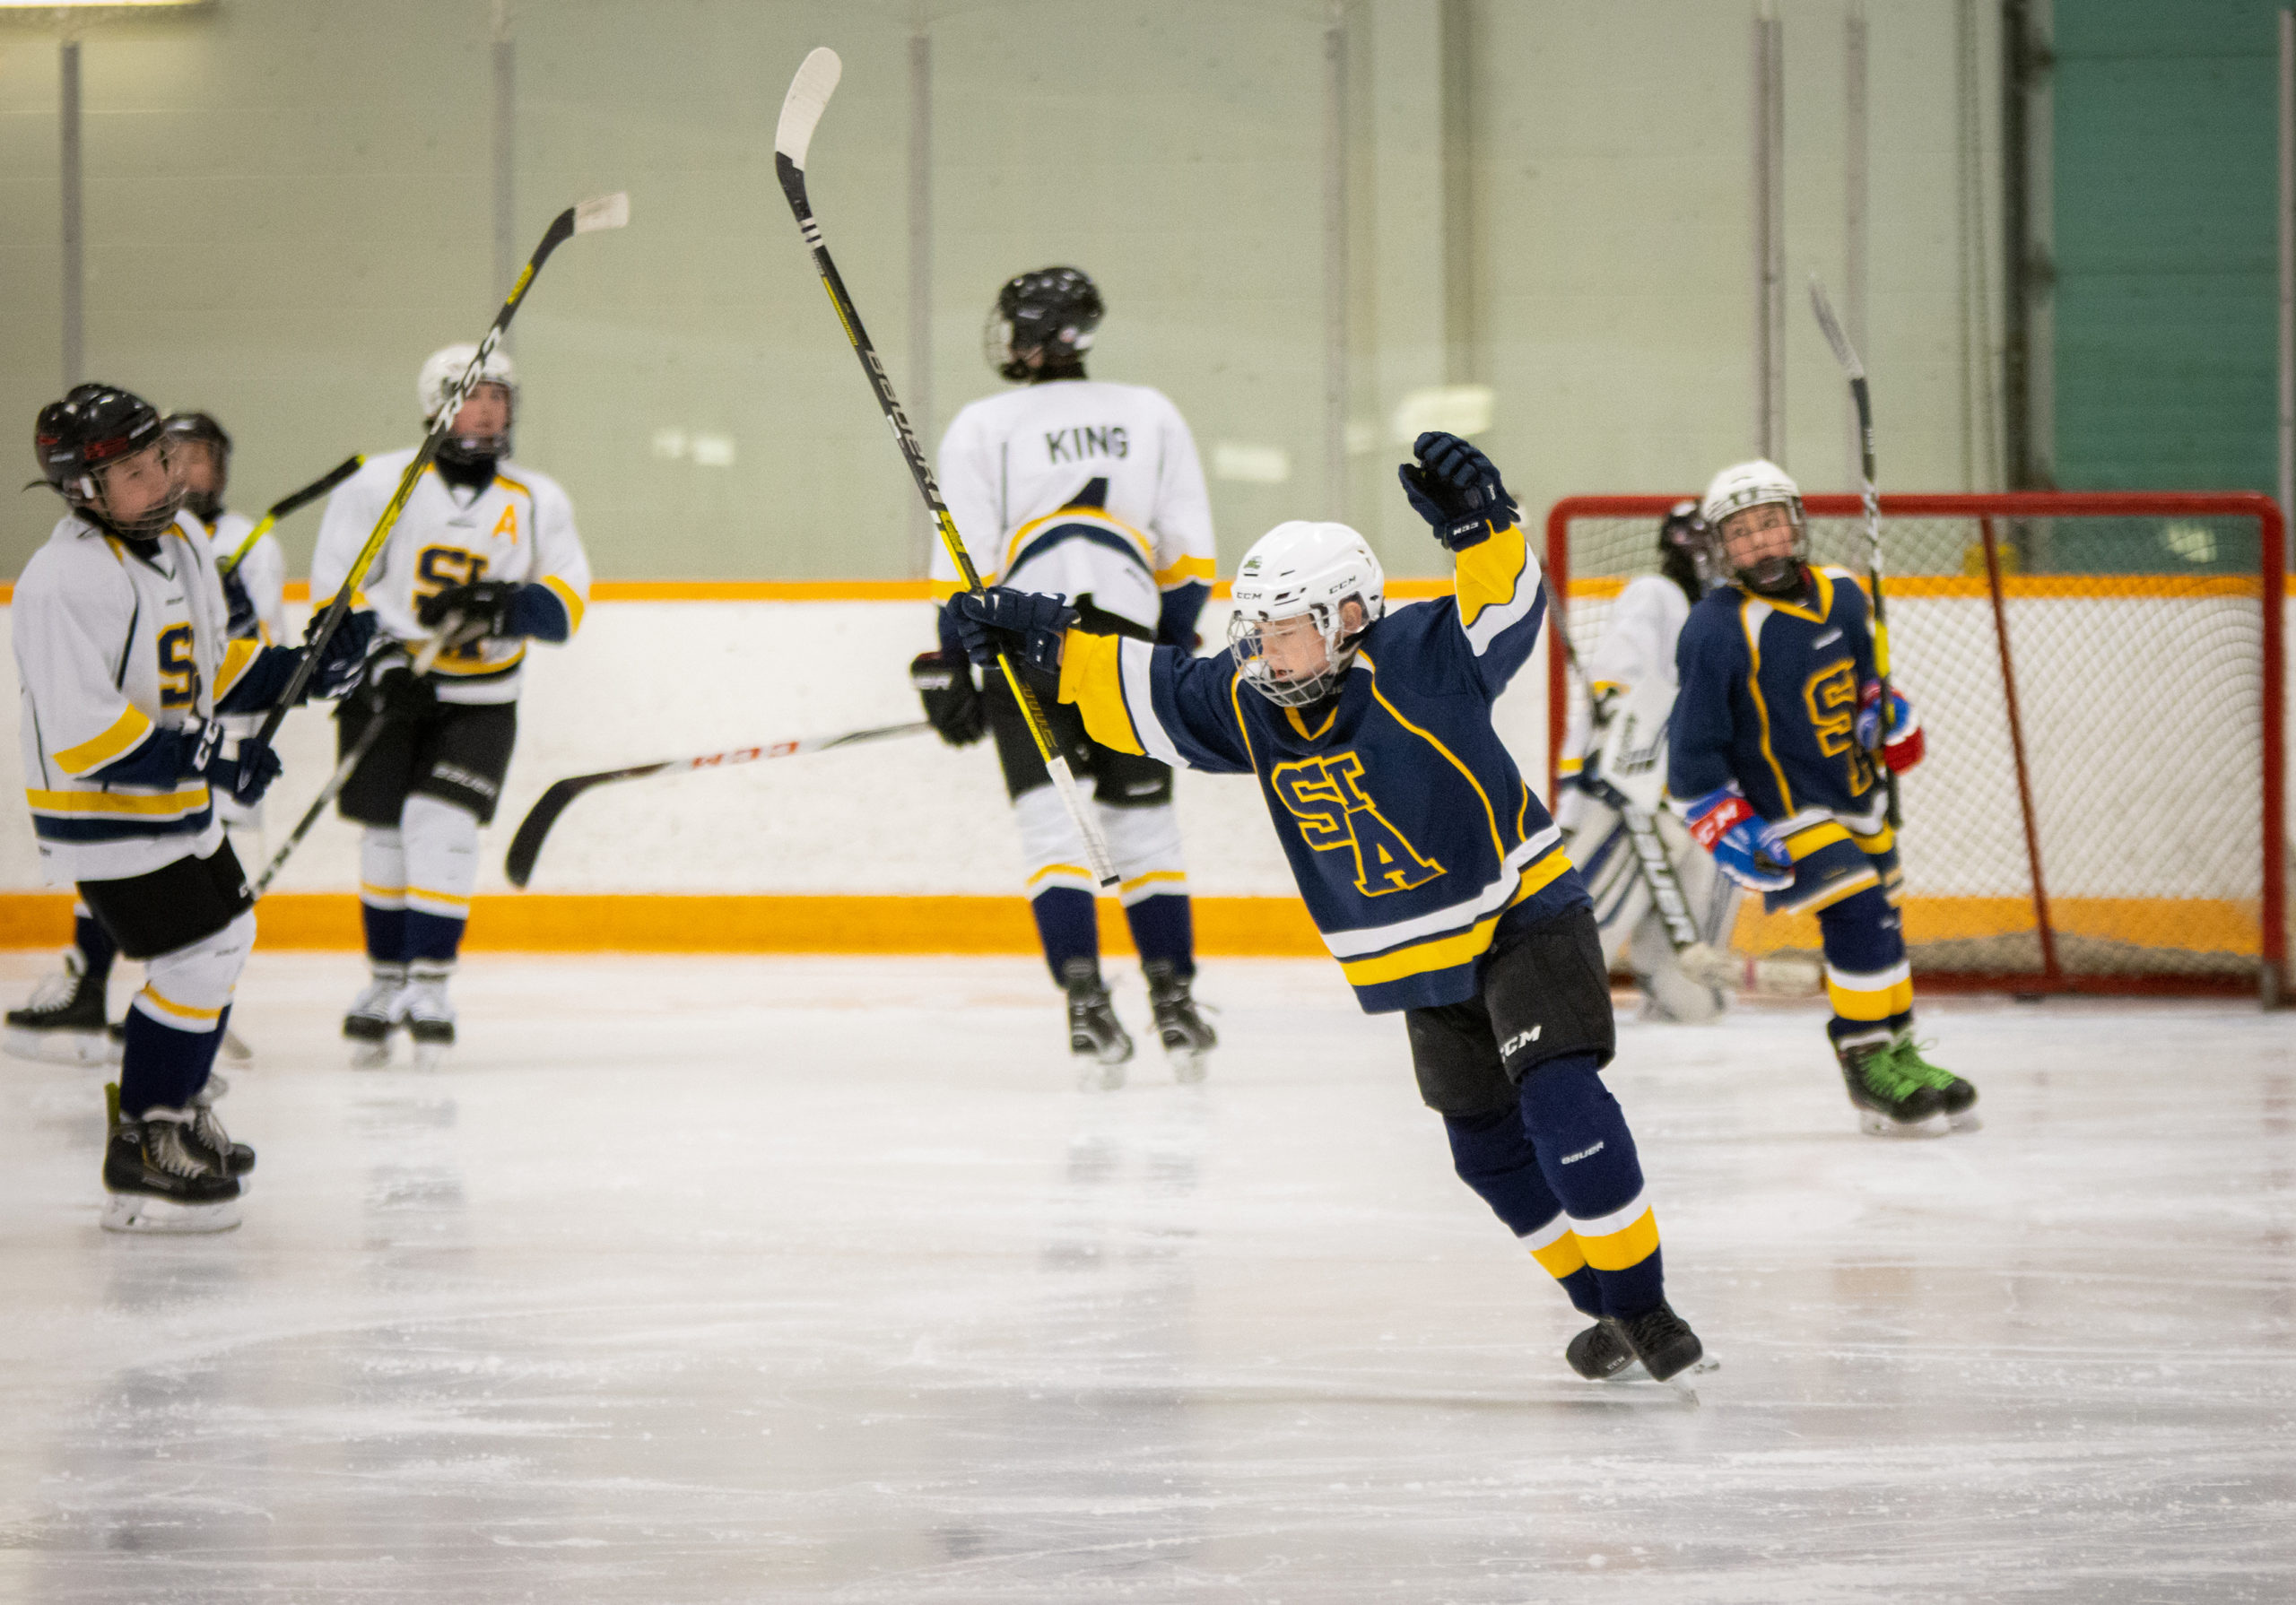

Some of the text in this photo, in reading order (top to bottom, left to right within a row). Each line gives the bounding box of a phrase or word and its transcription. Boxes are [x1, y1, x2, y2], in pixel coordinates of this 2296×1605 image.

[865, 349, 940, 492] BAUER
[1045, 425, 1128, 464] KING
[492, 503, 518, 546] A
[1453, 522, 1479, 536] CCM
[1236, 592, 1263, 601] CCM
[1328, 575, 1357, 594] CCM
[191, 720, 222, 772] CC
[1561, 1141, 1605, 1165] BAUER
